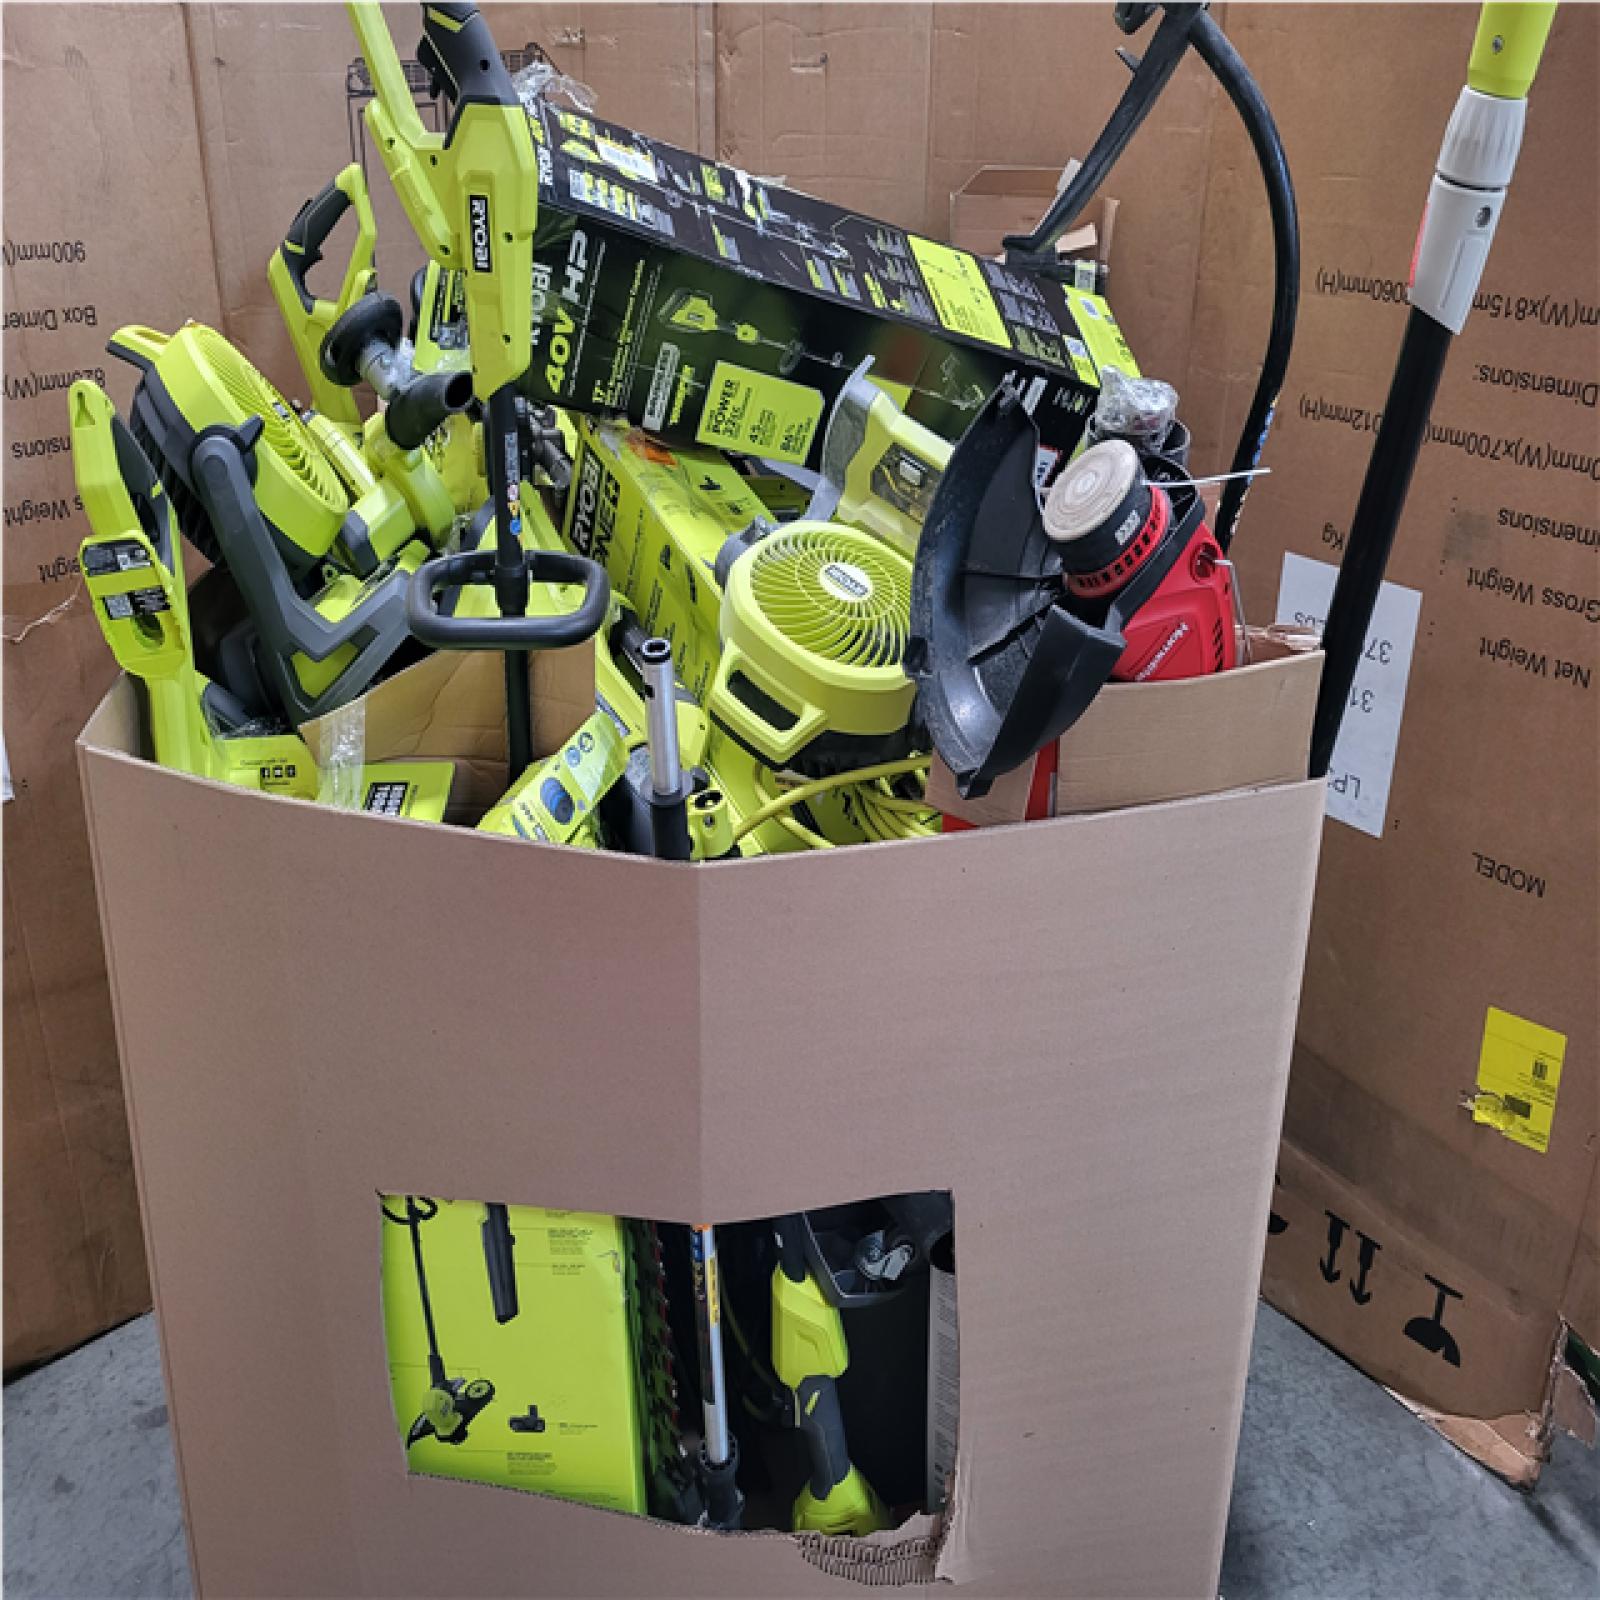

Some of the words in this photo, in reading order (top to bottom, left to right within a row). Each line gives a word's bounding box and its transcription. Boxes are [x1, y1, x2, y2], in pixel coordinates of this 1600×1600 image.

[471, 198, 490, 270] RYOBI
[62, 304, 98, 327] Box
[545, 306, 575, 395] 40V
[562, 229, 588, 304] HP
[1321, 522, 1346, 551] Kg
[1467, 567, 1534, 606] Weight
[1479, 637, 1546, 677] Weight
[1554, 659, 1591, 689] Net
[1471, 851, 1546, 898] MODEL
